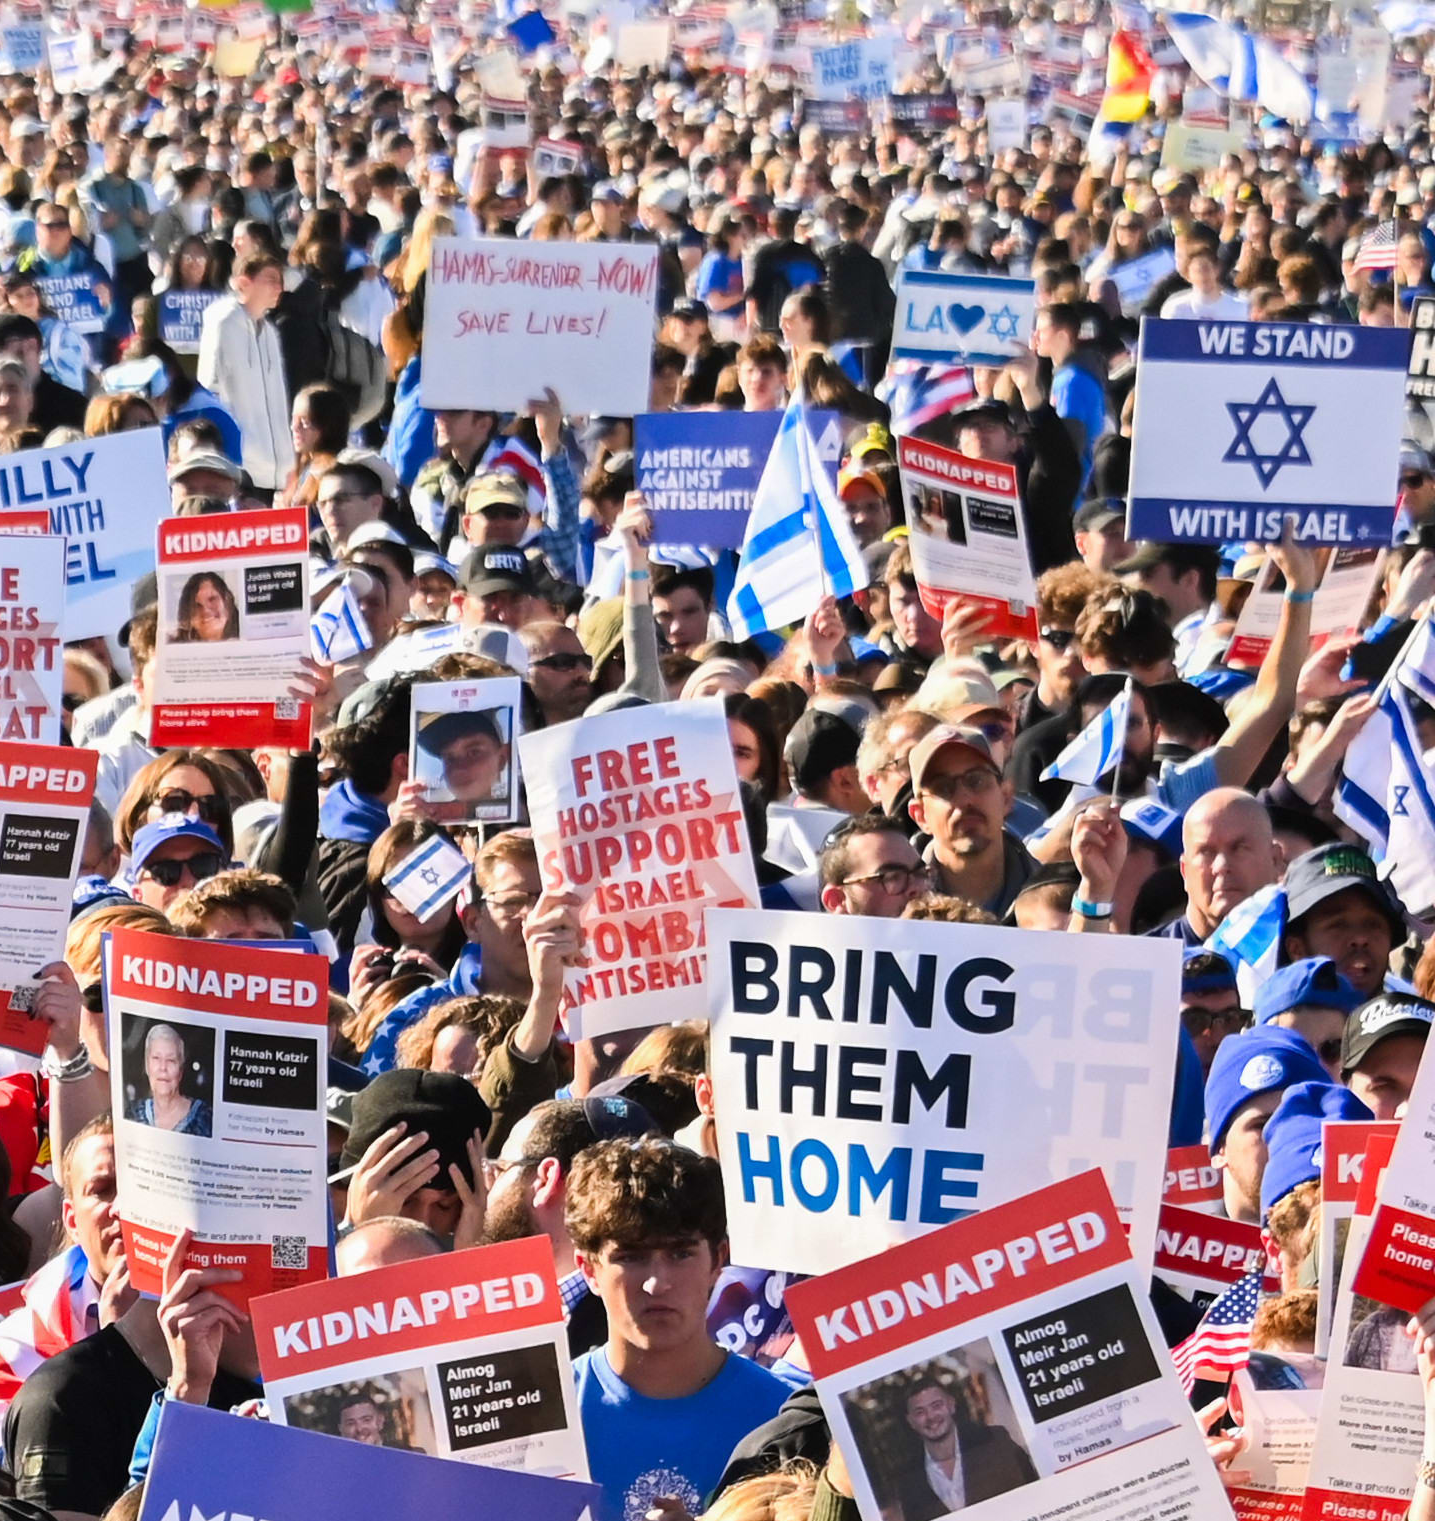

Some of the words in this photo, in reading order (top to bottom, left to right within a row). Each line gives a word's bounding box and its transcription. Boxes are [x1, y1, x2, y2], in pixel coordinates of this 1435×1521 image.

[454, 310, 511, 337] SAVE
[527, 309, 606, 338] LIVES!
[1198, 327, 1247, 357] WE
[1253, 328, 1355, 359] STAND
[640, 449, 750, 468] AMERICANS
[640, 470, 722, 489] AGAINST
[904, 449, 1012, 491] KIDNAPPED
[165, 523, 301, 554] KIDNAPPED
[1170, 508, 1251, 541] WITH
[1256, 511, 1351, 542] ISRAEL
[572, 735, 681, 797] FREE
[557, 778, 711, 838] HOSTAGES
[543, 809, 742, 891] SUPPORT
[597, 868, 707, 915] ISRAEL
[120, 955, 319, 1009] KIDNAPPED
[730, 941, 1017, 1034] BRING
[230, 1043, 269, 1061] Hannah
[273, 1048, 309, 1064] Katzir
[730, 1036, 970, 1129] THEM
[737, 1132, 984, 1218] HOME
[815, 1210, 1108, 1353] KIDNAPPED
[273, 1273, 546, 1358] KIDNAPPED
[1012, 1316, 1067, 1349] Almog
[1019, 1342, 1054, 1367] Meir
[1059, 1331, 1090, 1354] Jan
